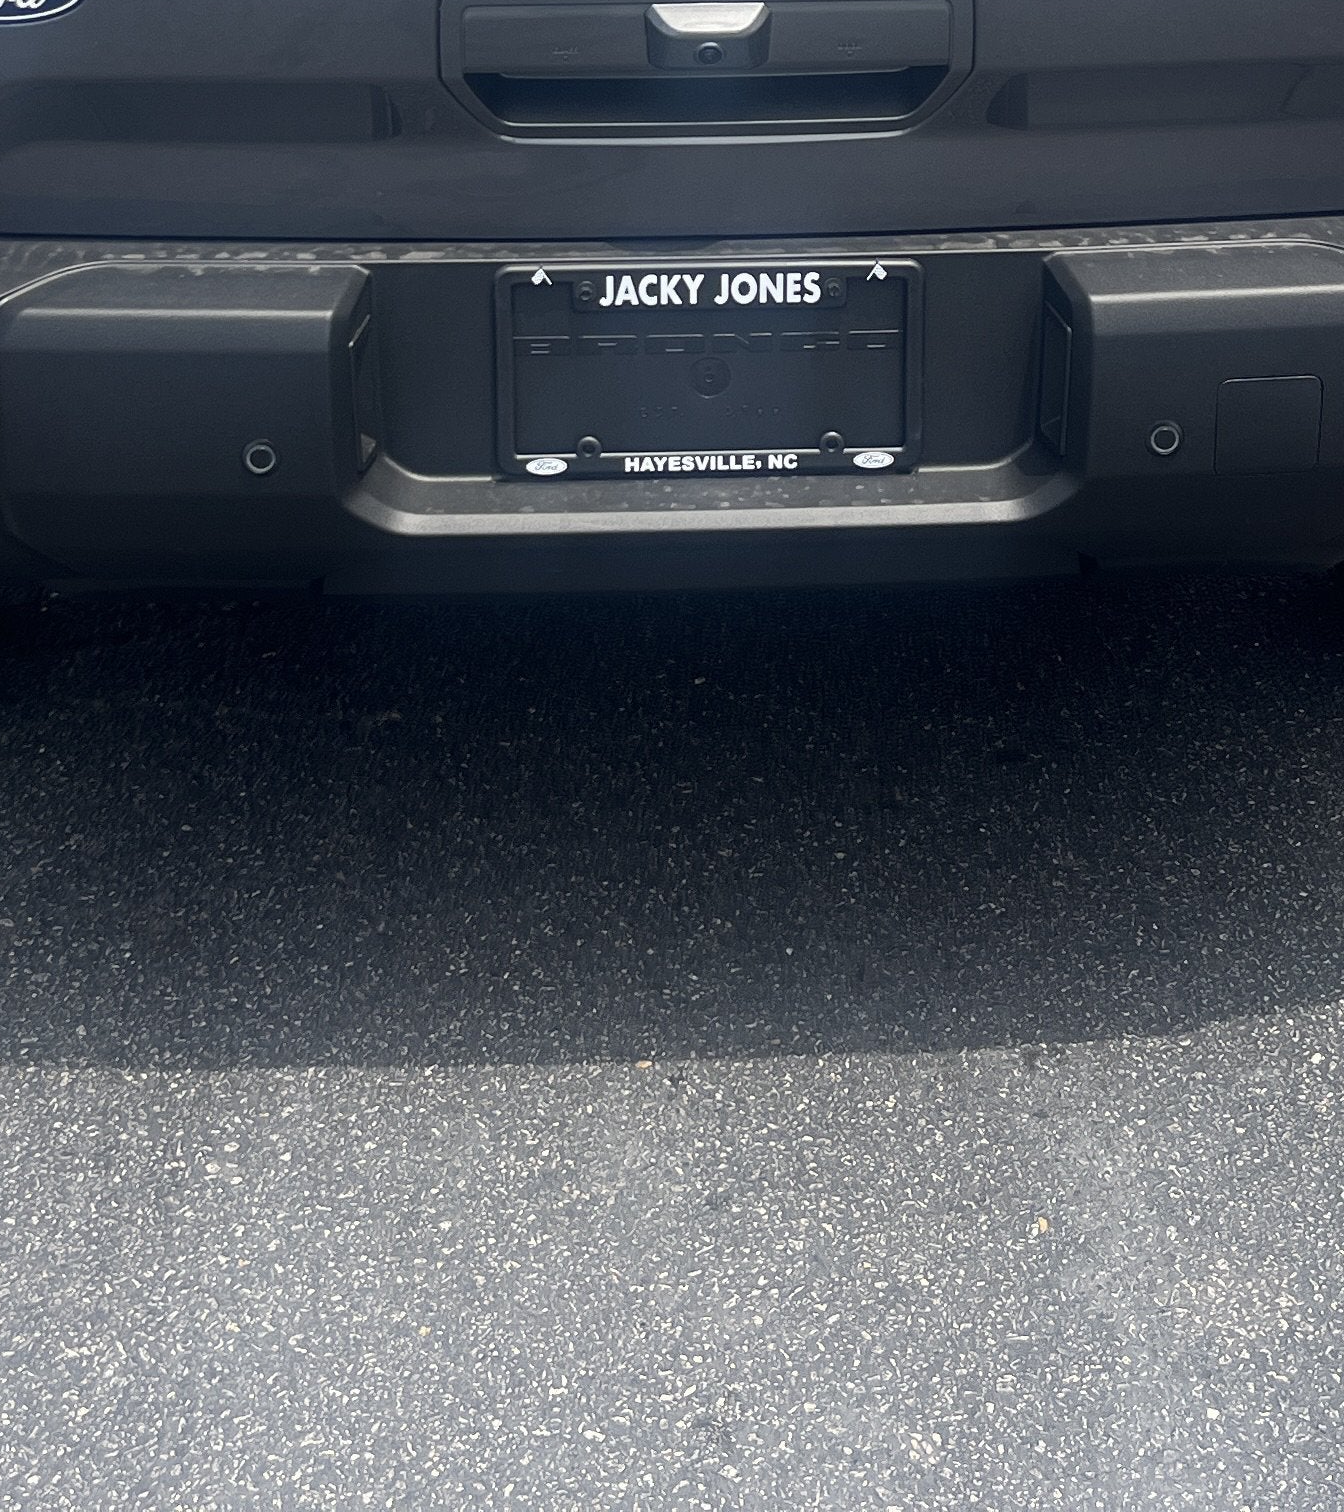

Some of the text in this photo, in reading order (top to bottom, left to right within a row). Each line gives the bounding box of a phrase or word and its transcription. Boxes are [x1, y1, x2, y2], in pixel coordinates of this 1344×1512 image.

[598, 272, 822, 307] JACKY JONES
[623, 453, 799, 473] HAYESVILLE, NC
